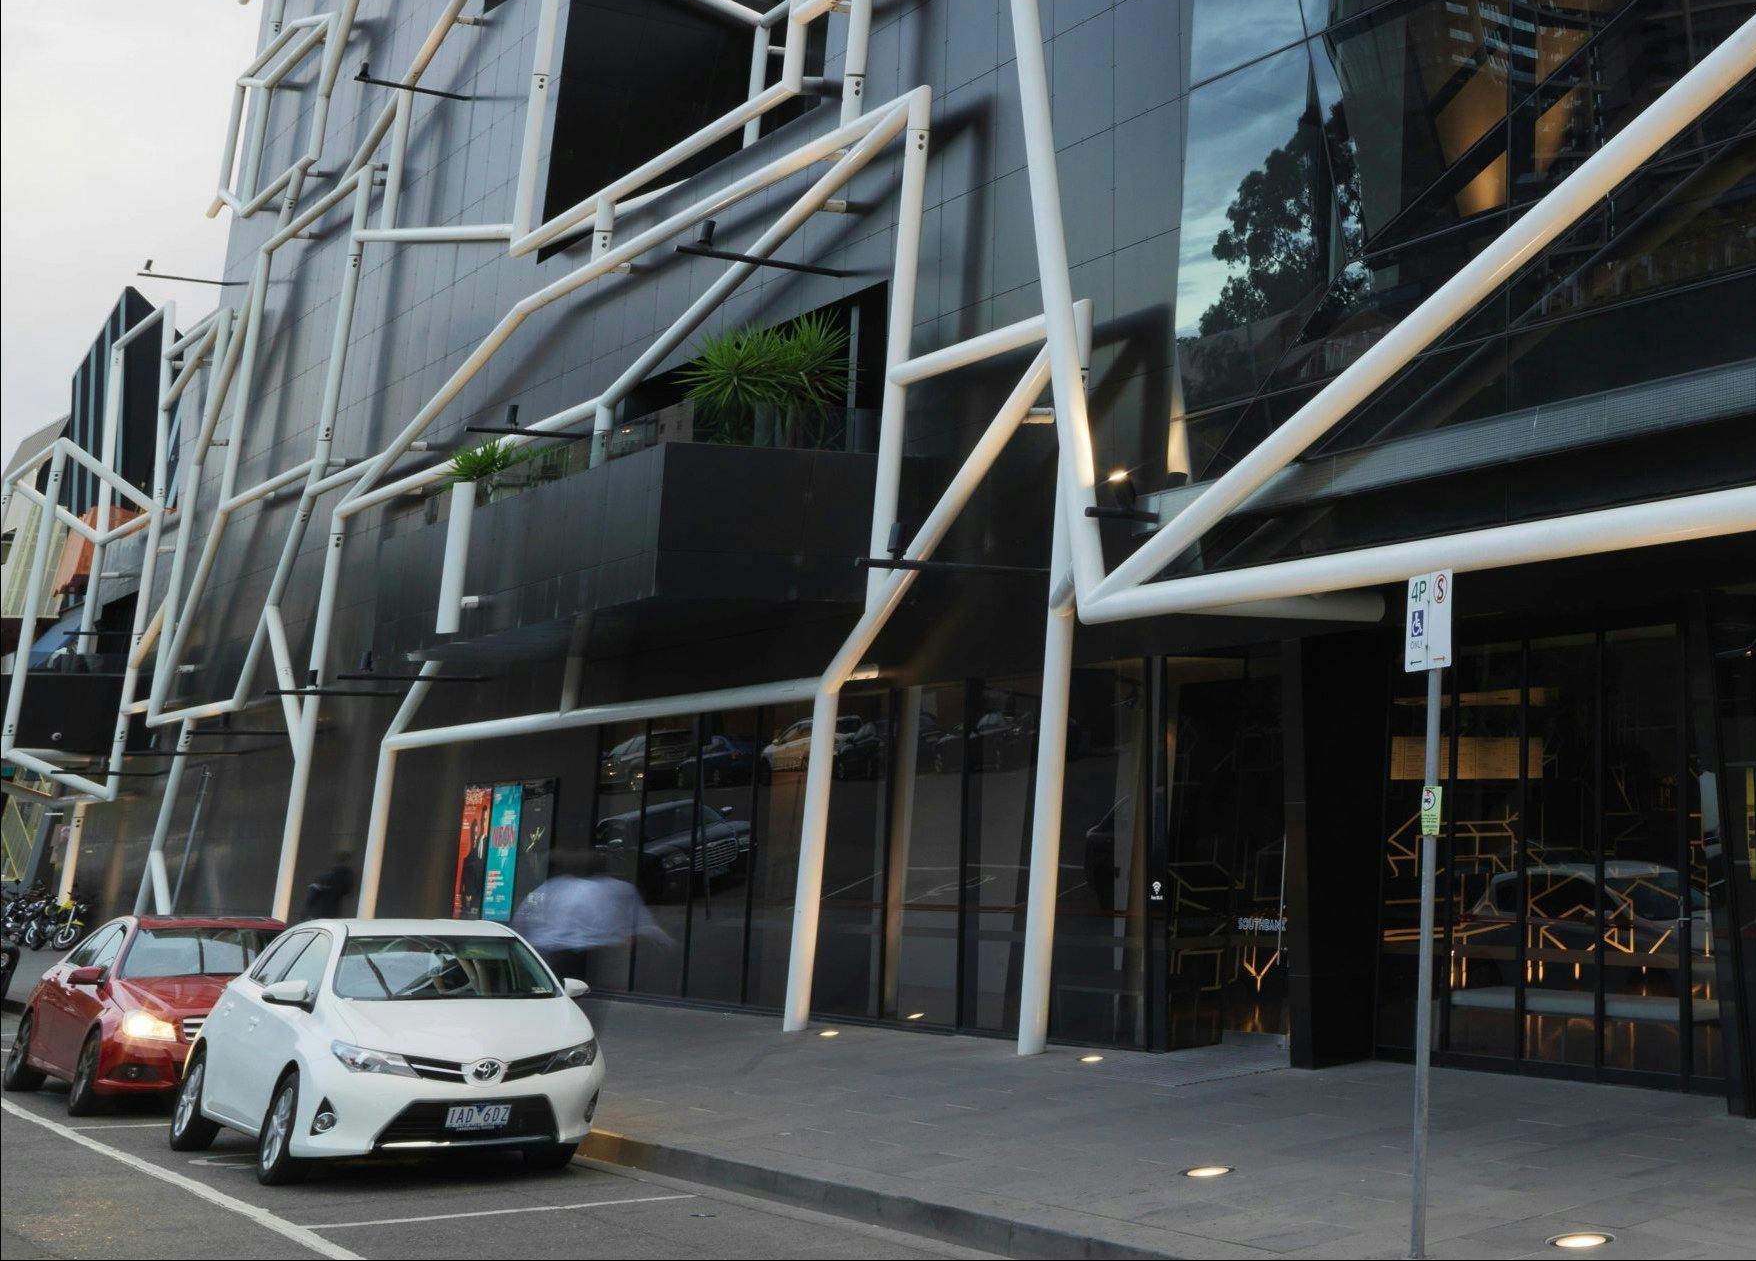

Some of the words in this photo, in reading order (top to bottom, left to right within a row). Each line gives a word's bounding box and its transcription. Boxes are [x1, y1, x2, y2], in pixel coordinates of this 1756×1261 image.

[1411, 580, 1427, 602] 4P
[1410, 641, 1423, 650] ONLY
[1238, 917, 1287, 931] SOUTHBANK
